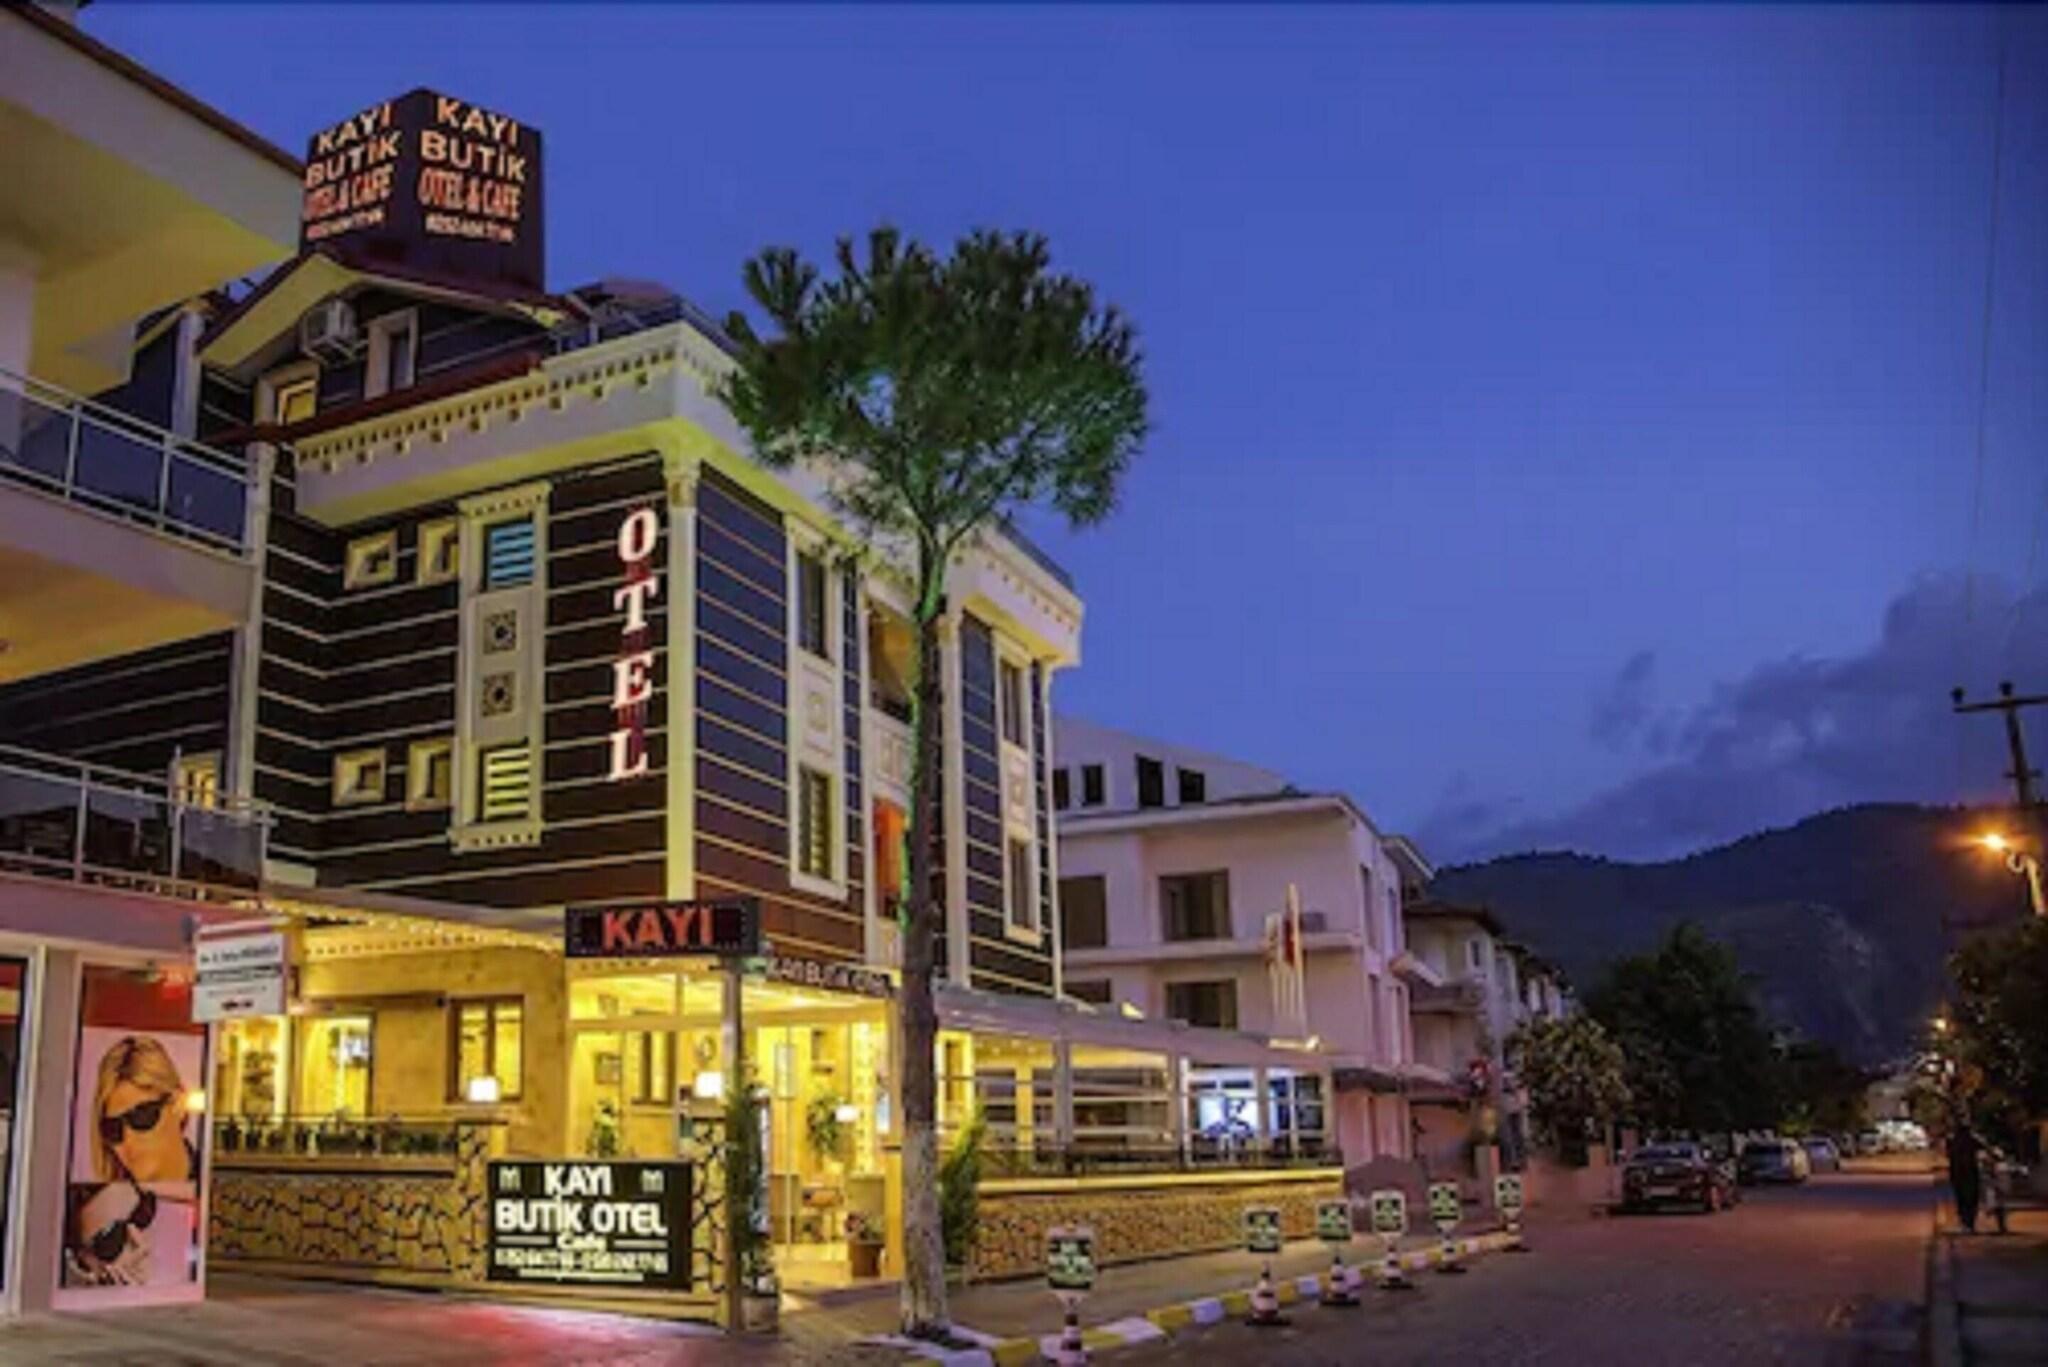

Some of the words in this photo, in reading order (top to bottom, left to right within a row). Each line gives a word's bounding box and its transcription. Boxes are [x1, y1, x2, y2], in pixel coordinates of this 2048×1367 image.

[317, 103, 392, 153] KAYI
[437, 97, 519, 147] KAYI
[418, 166, 465, 210] OTEL
[482, 180, 521, 221] CAFE
[610, 507, 659, 783] OTEL
[603, 905, 715, 951] KAYI
[543, 1165, 613, 1196] KAYI
[591, 1202, 669, 1237] OTEL
